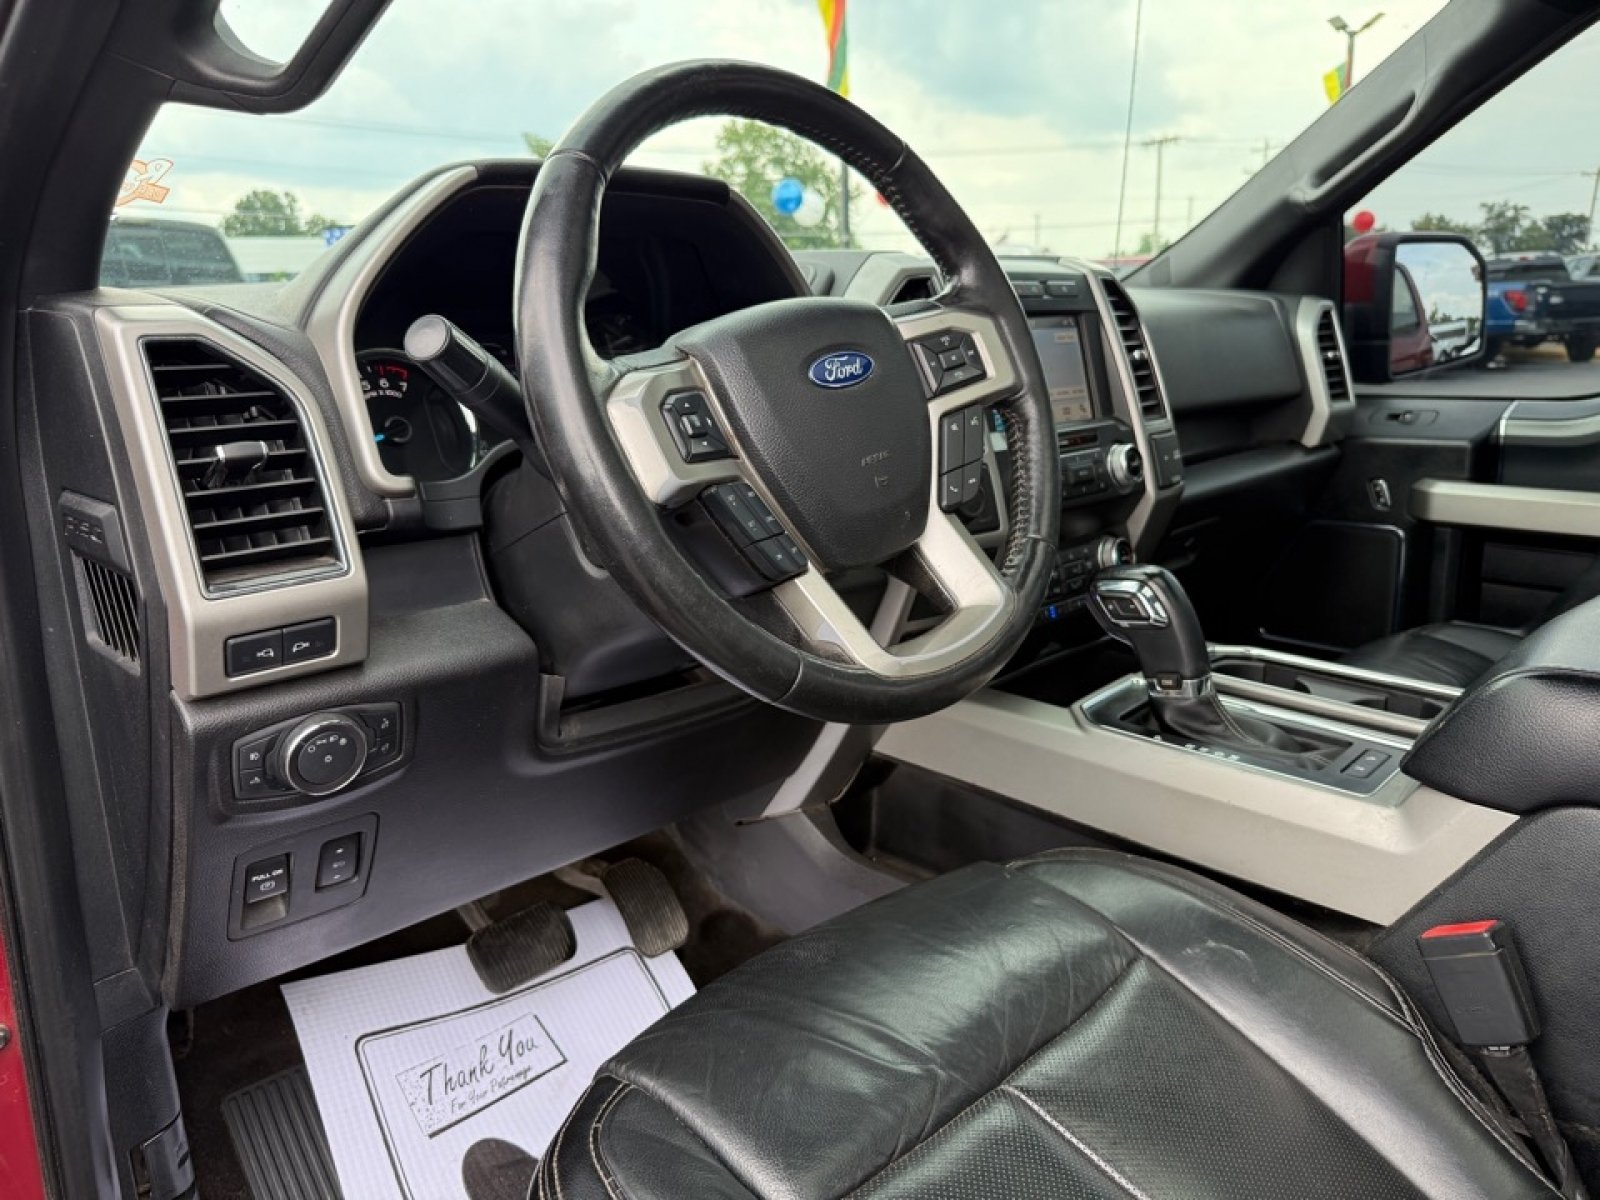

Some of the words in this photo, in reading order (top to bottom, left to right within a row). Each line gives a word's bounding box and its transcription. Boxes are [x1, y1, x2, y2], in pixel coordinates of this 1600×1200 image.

[824, 354, 864, 382] Ford
[379, 377, 389, 389] 6
[399, 381, 408, 392] 7
[419, 1044, 495, 1106] Thank
[498, 1028, 539, 1066] You
